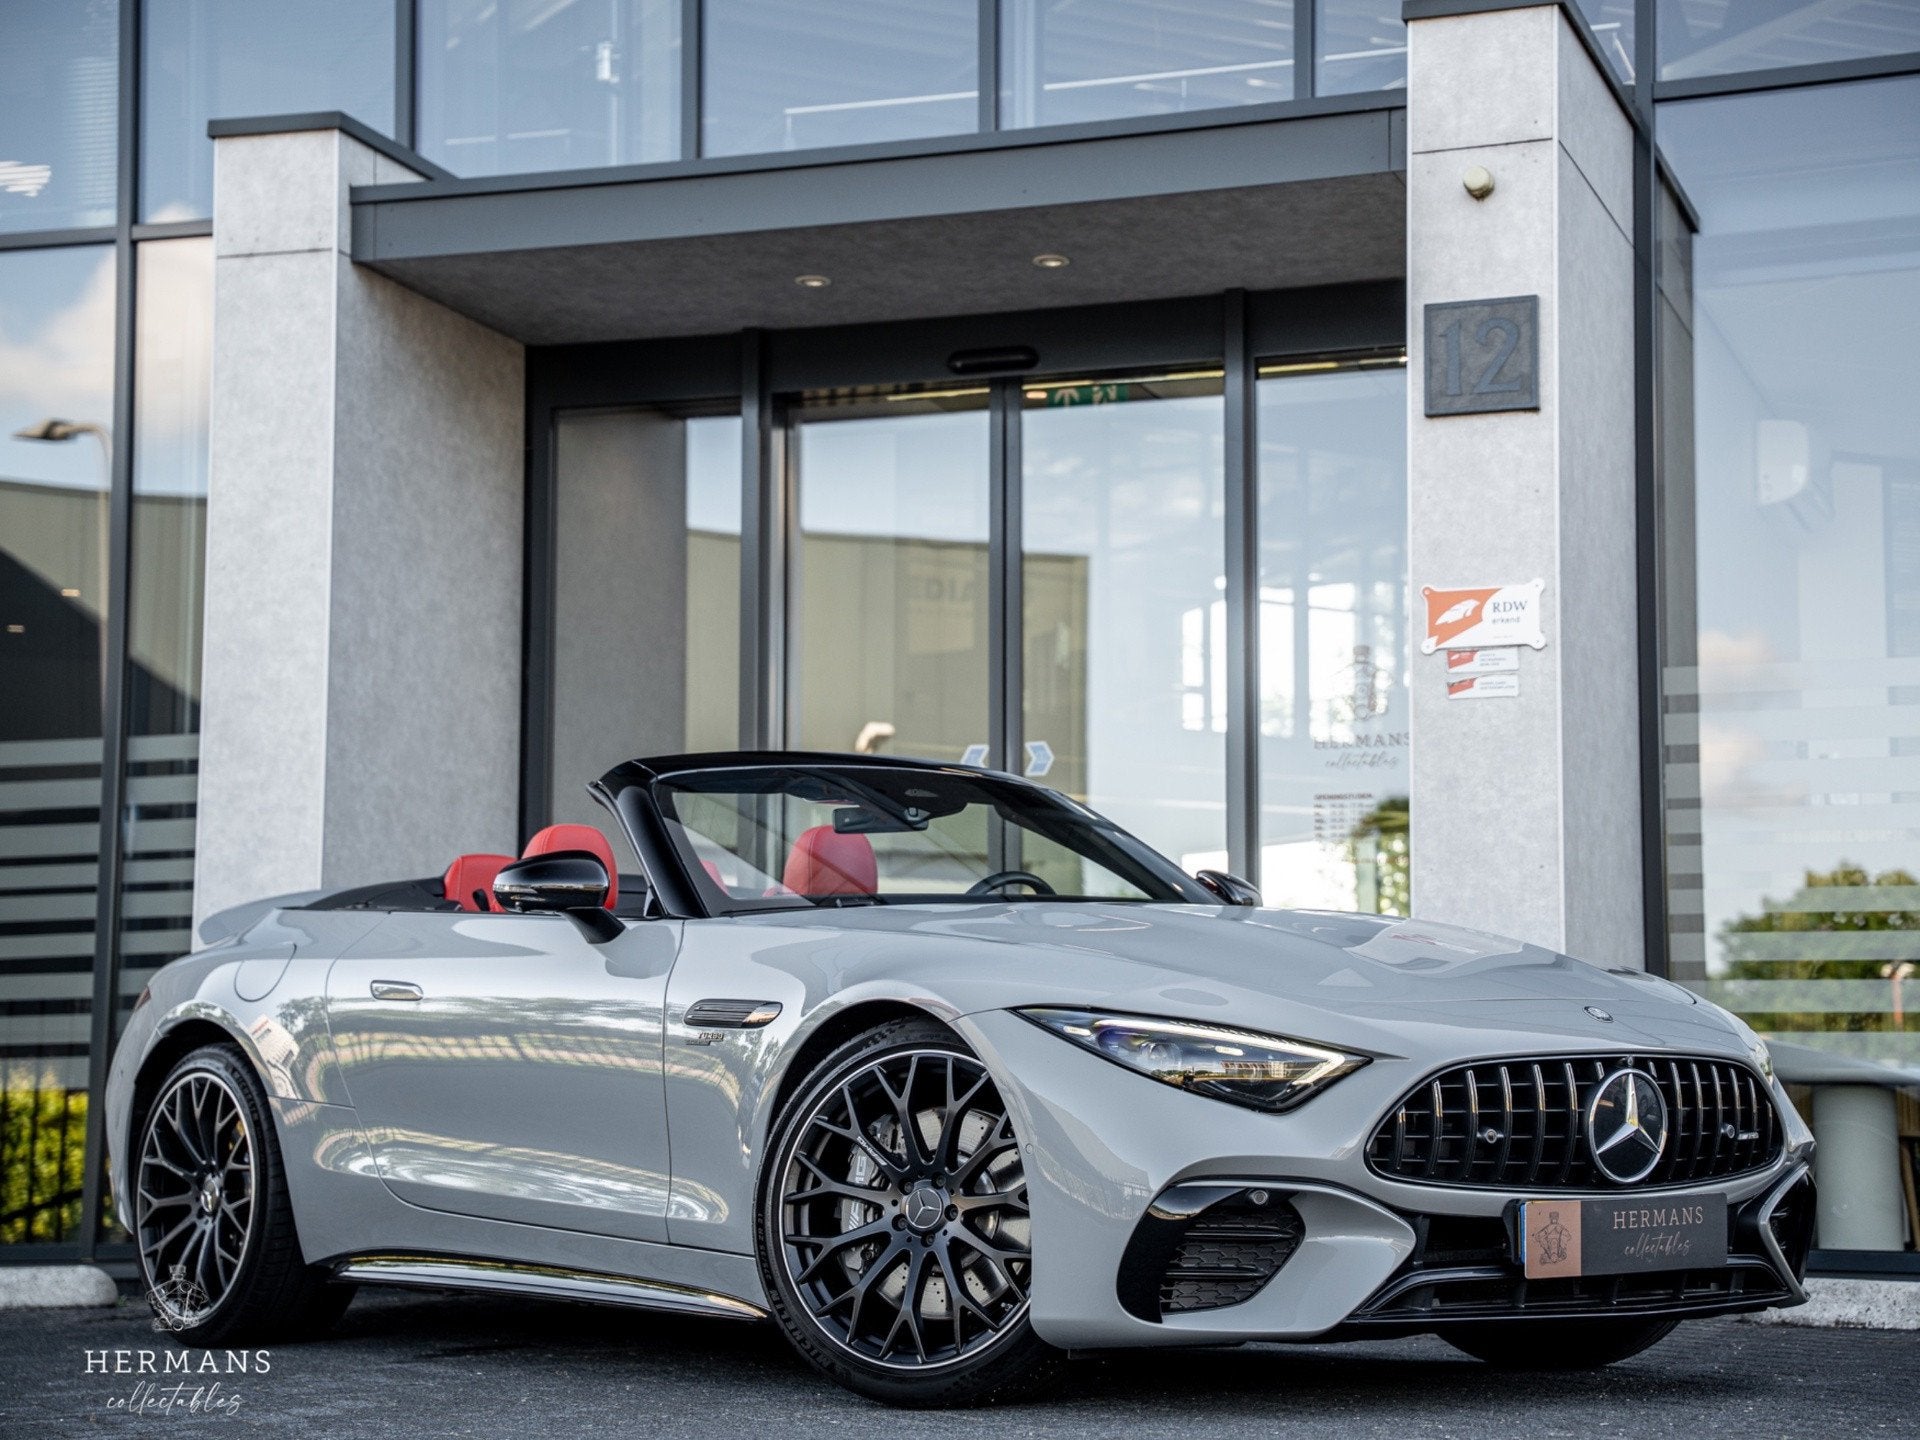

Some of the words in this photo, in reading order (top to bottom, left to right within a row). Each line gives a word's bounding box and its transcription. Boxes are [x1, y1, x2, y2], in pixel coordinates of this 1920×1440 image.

[1439, 318, 1521, 397] 12
[1492, 600, 1528, 613] RDW
[1613, 1206, 1704, 1230] HERMANS
[1624, 1231, 1692, 1259] collectables
